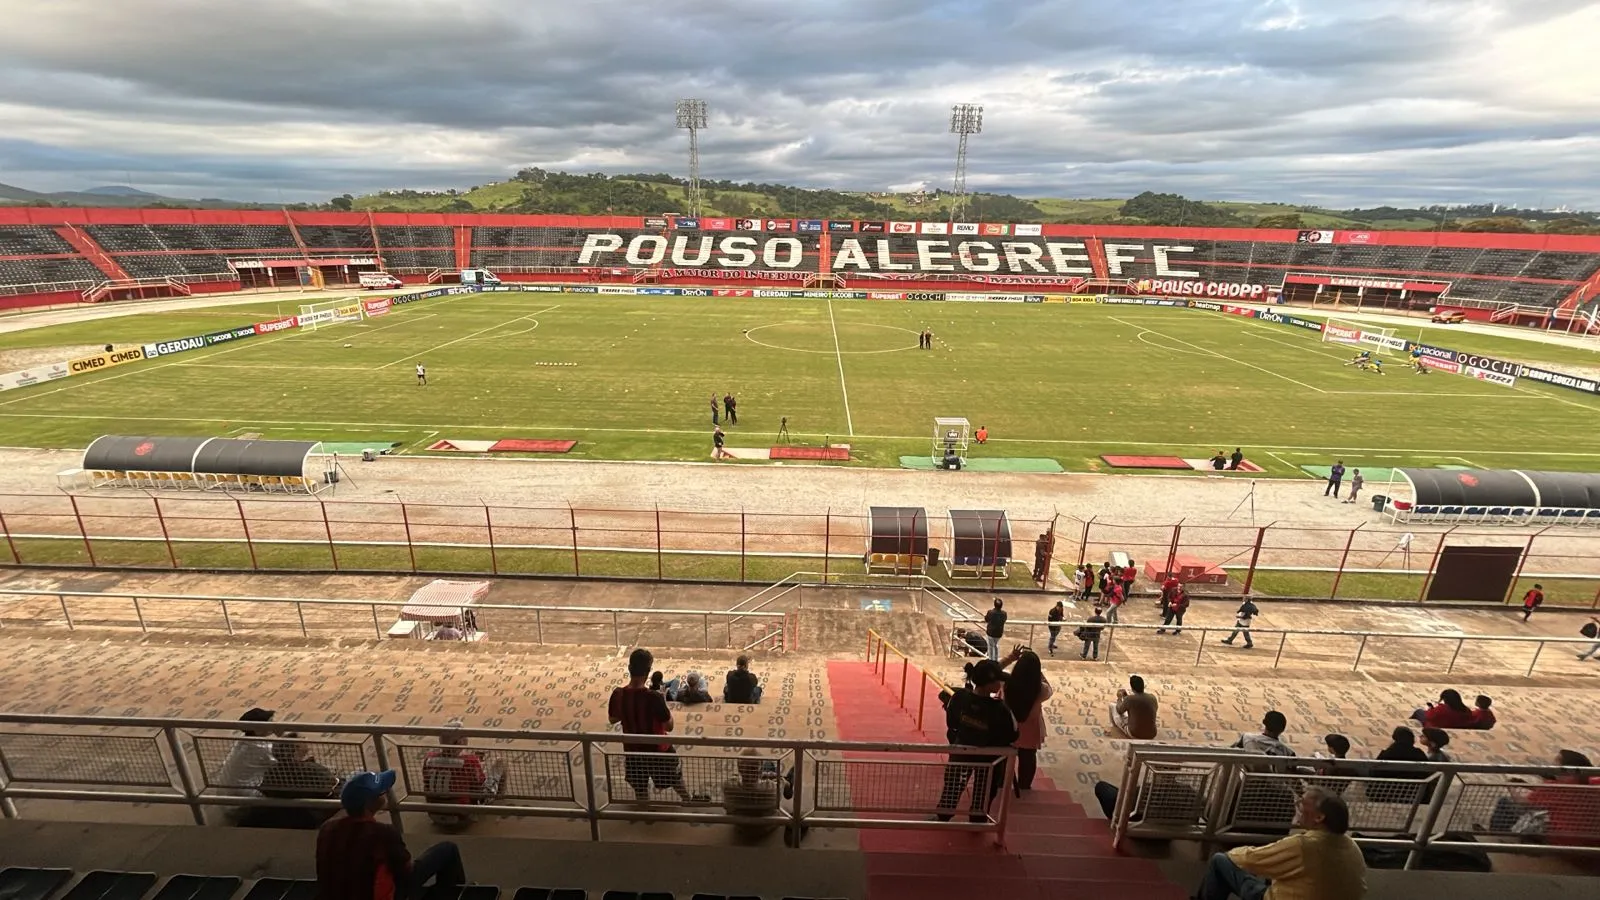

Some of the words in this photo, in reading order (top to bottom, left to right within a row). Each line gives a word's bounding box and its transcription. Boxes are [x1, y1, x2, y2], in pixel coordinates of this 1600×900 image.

[577, 234, 803, 268] POUSO
[832, 238, 1093, 274] ALEGRE
[1105, 244, 1199, 277] FC
[662, 270, 672, 278] A
[674, 269, 718, 278] MAIOR
[722, 270, 740, 279] DO
[448, 286, 473, 295] start
[1152, 280, 1203, 294] POUSO
[1206, 283, 1262, 298] CHOPP
[260, 317, 294, 332] SUPERBET
[212, 333, 232, 342] SICOOB
[158, 337, 204, 354] GERDAU
[72, 357, 106, 372] CIMED
[110, 350, 141, 363] CIMED
[1422, 357, 1458, 370] SUPERBET
[1458, 354, 1519, 376] OGOCHI
[1529, 370, 1552, 382] GRUPO
[1552, 374, 1576, 386] SOUZA
[1576, 379, 1596, 392] LIMA
[1188, 568, 1196, 577] 1
[501, 697, 514, 705] 10
[812, 699, 824, 707] 01
[465, 705, 481, 714] 10
[498, 707, 516, 715] 09
[536, 708, 553, 716] 08
[573, 709, 591, 718] 07
[738, 705, 754, 713] 03
[775, 707, 790, 715] 02
[808, 708, 821, 716] 01
[1078, 708, 1095, 717] 77
[365, 715, 383, 724] 12
[408, 716, 423, 725] 11
[685, 713, 702, 722] 04
[725, 715, 740, 723] 03
[768, 716, 783, 725] 02
[807, 717, 823, 726] 01
[1048, 716, 1065, 724] 78
[1085, 718, 1100, 726] 77
[483, 718, 502, 727] 09
[521, 720, 541, 729] 08
[562, 721, 581, 730] 07
[684, 726, 704, 736] 04
[725, 728, 743, 736] 03
[768, 729, 786, 738] 02
[809, 730, 826, 739] 01
[1056, 727, 1073, 735] 79
[1068, 740, 1088, 749] 80
[1080, 754, 1102, 765] 80
